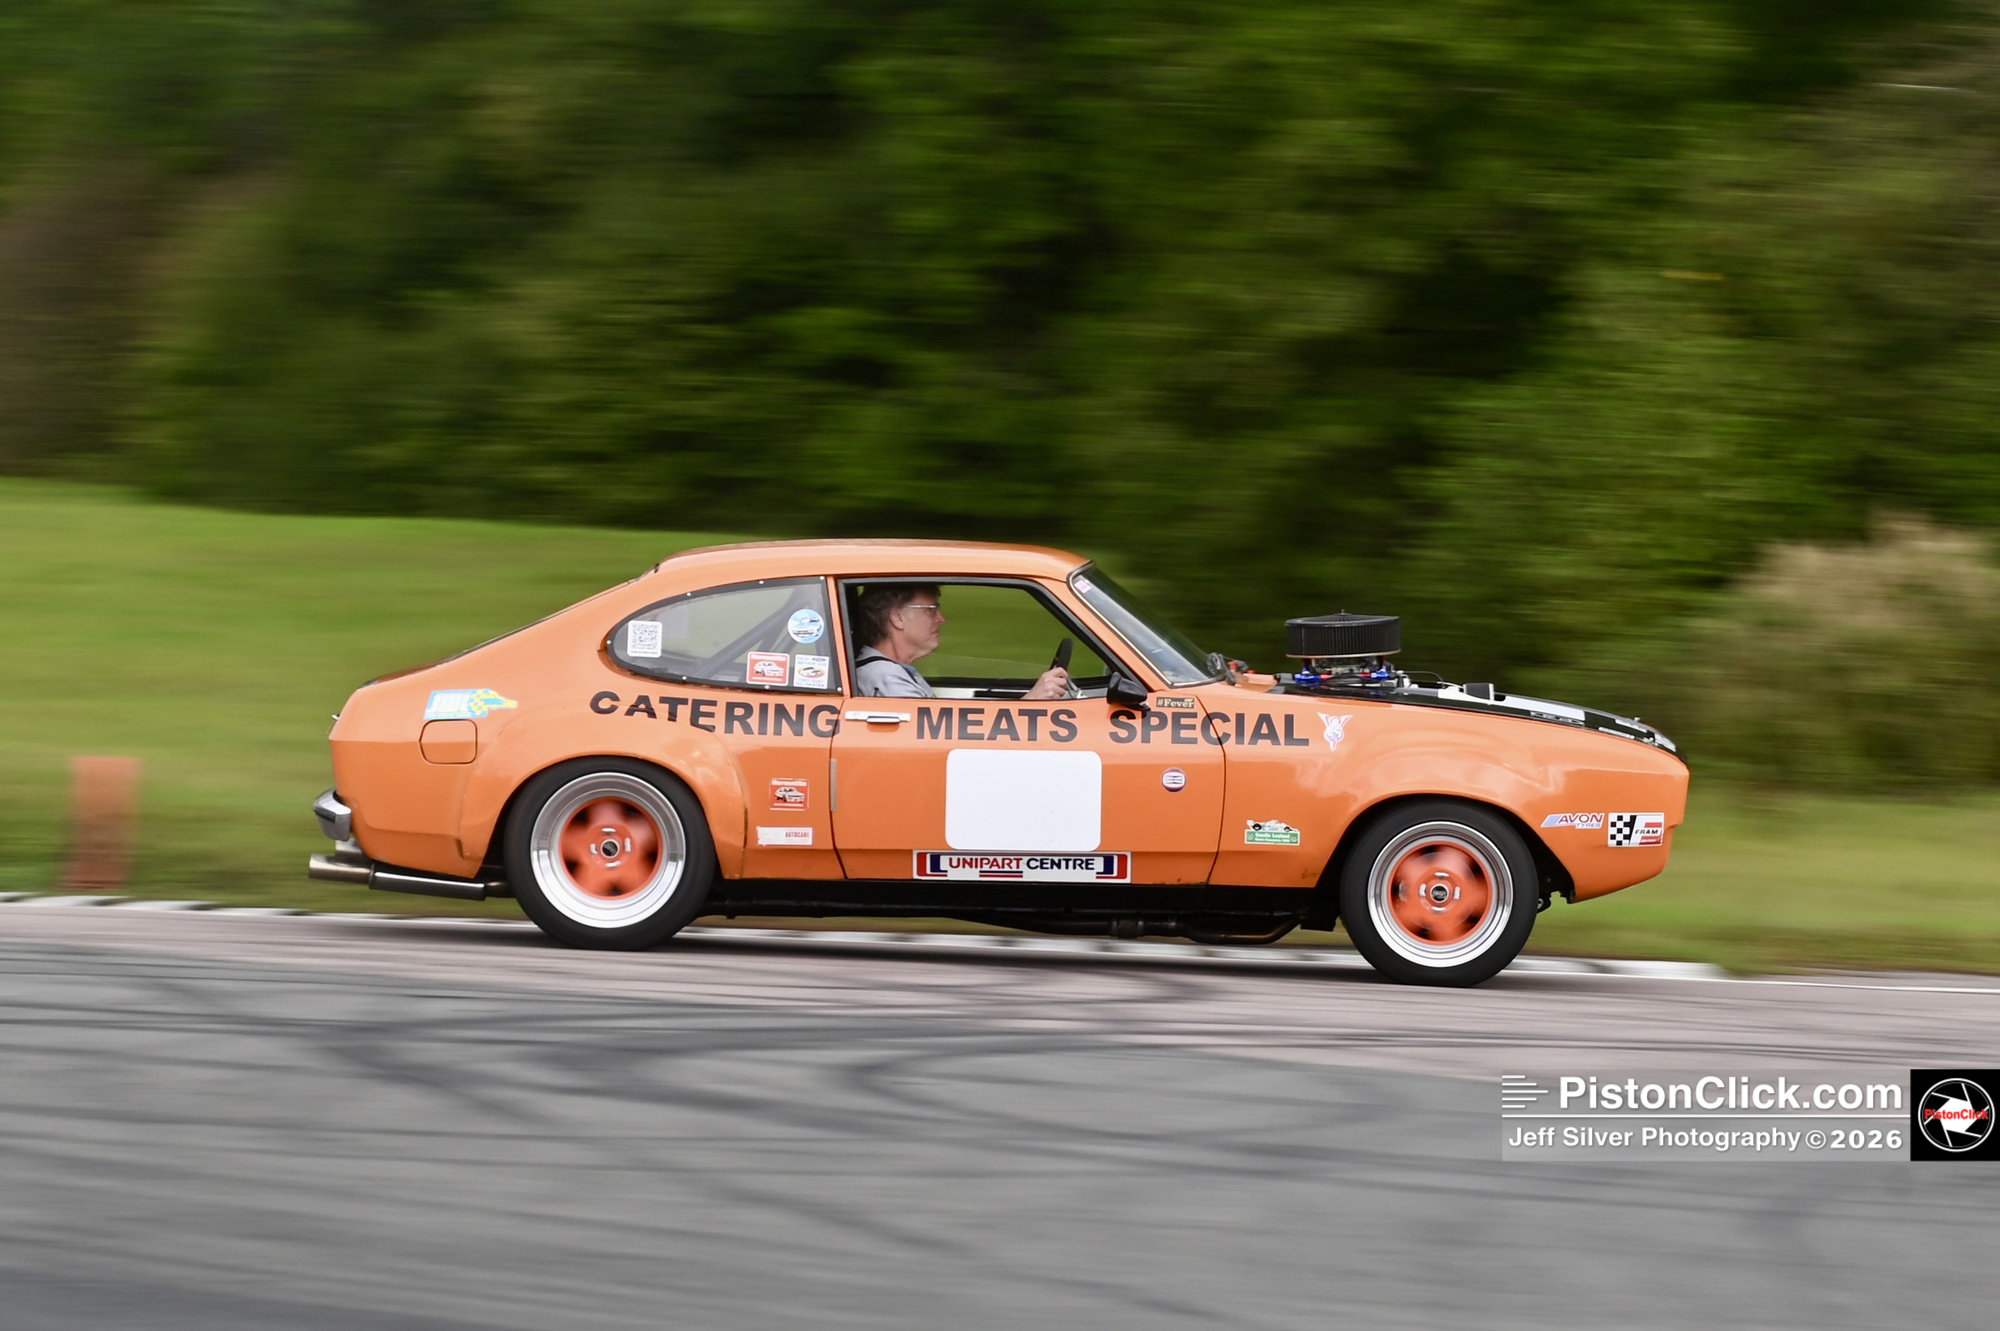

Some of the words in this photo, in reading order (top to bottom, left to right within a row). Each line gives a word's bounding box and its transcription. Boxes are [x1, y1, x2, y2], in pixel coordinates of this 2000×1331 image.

[589, 691, 840, 738] CATERING
[917, 707, 1078, 742] MEATS
[1109, 709, 1309, 746] SPECIAL
[1558, 813, 1603, 824] AVON
[948, 857, 1023, 870] UNIPART
[1026, 857, 1095, 870] CENTRE
